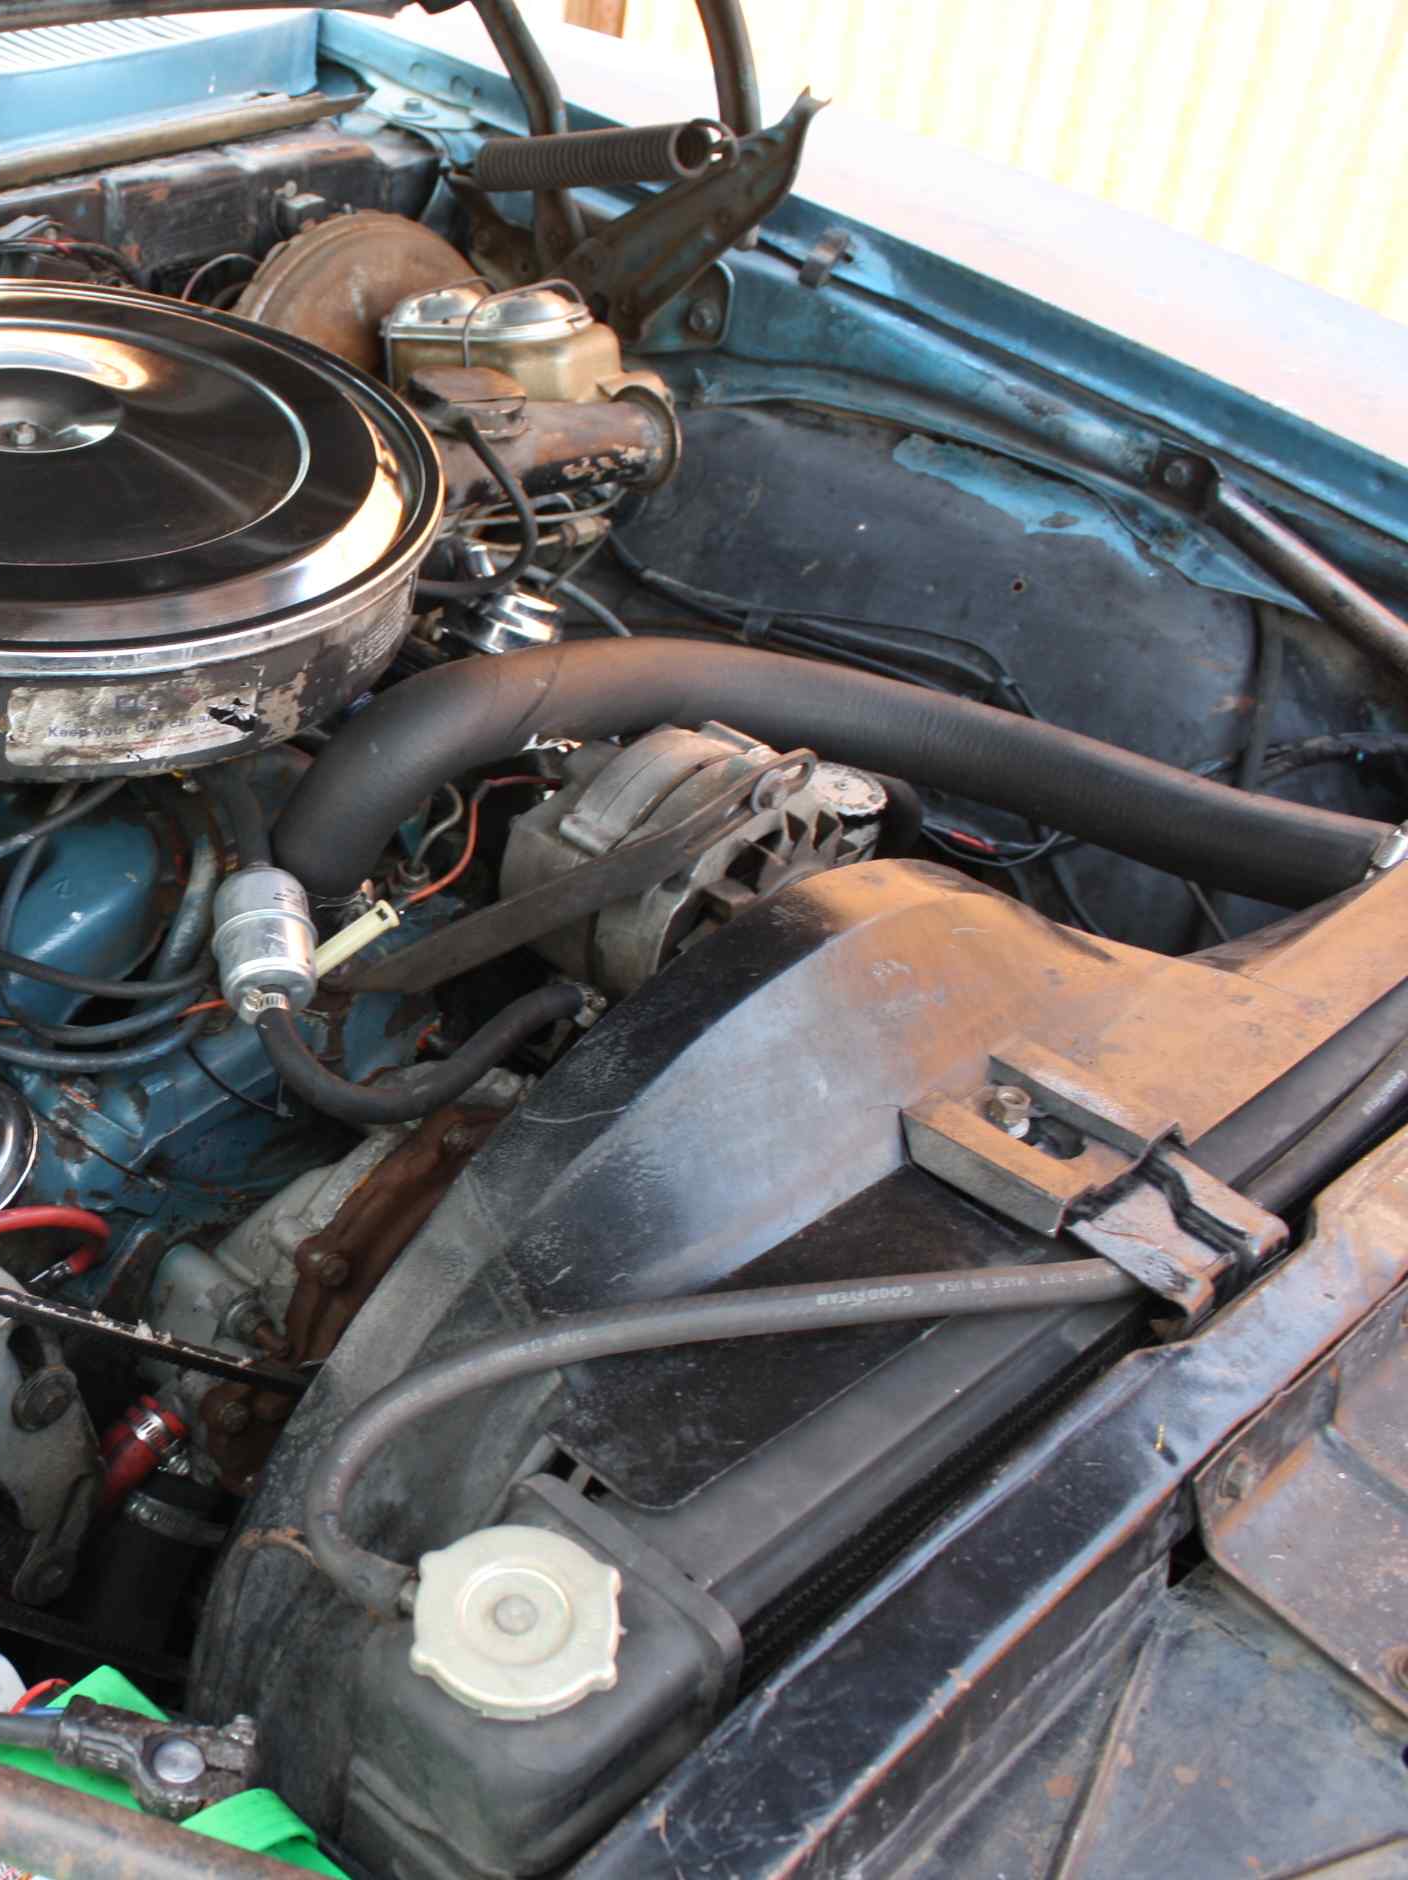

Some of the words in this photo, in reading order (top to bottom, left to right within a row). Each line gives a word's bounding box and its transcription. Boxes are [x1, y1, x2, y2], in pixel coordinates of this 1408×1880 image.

[48, 726, 89, 738] Keep
[94, 726, 128, 738] your
[135, 719, 163, 733] GM
[169, 719, 191, 728] car
[936, 1279, 967, 1293] USA
[815, 1285, 914, 1307] GOODYEAR
